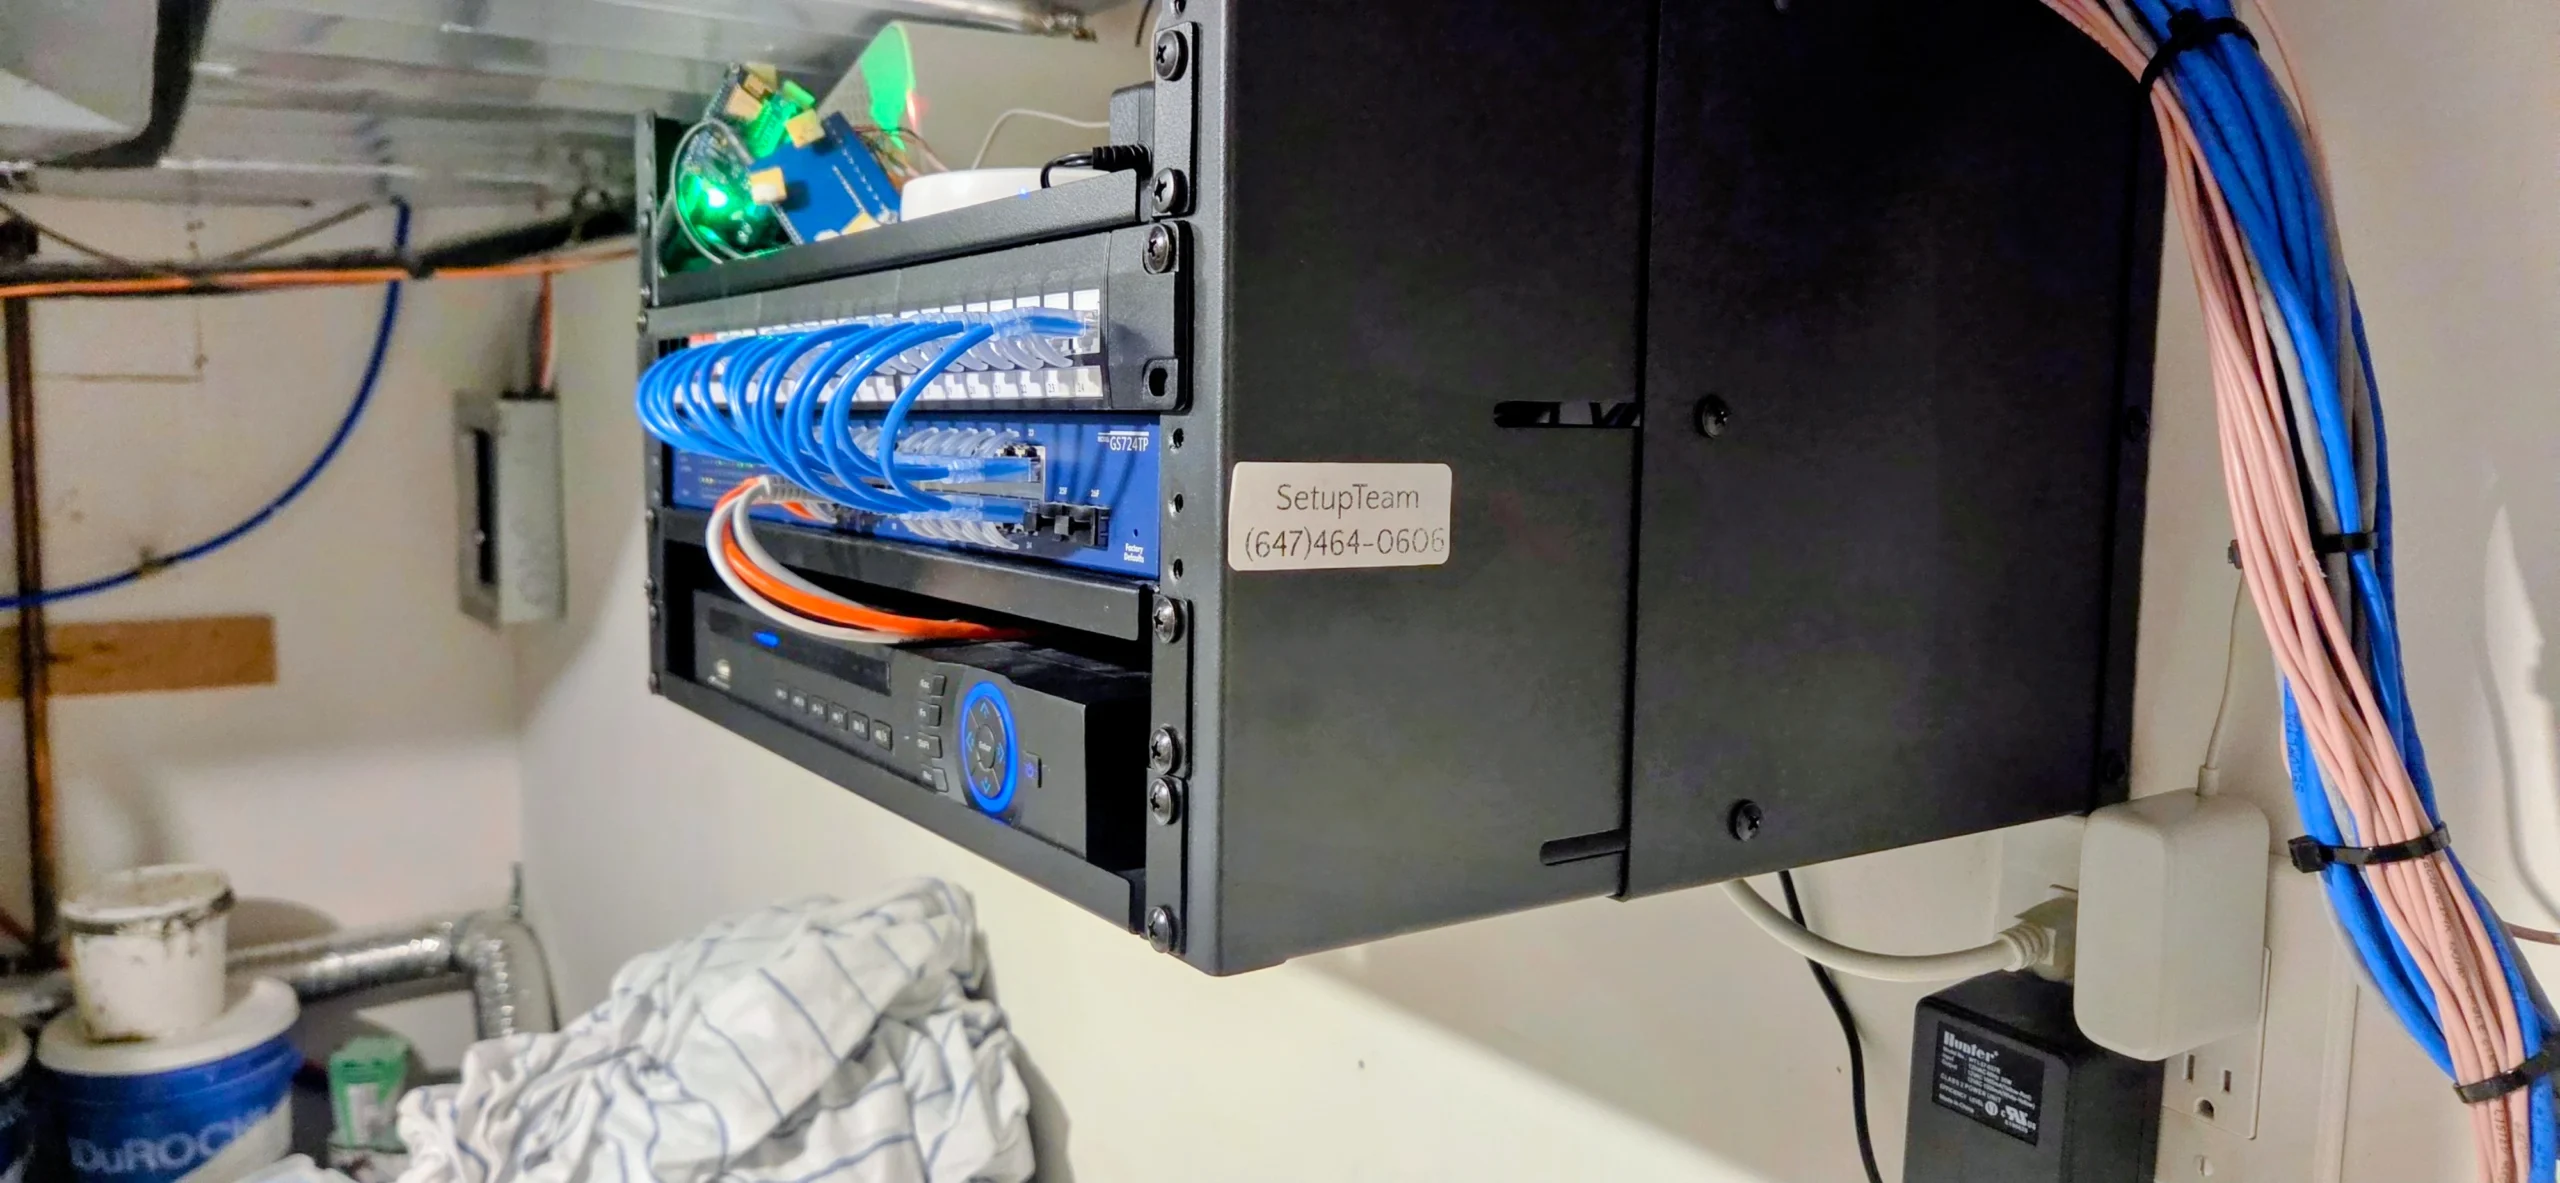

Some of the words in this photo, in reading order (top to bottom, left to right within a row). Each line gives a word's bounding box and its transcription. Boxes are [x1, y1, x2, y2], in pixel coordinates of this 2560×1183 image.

[1048, 383, 1055, 393] 23
[1077, 382, 1085, 392] 24
[1109, 436, 1149, 452] GS724TP
[1276, 483, 1419, 519] SetupTeam
[1245, 526, 1444, 562] (647)464-0606
[1943, 1030, 1995, 1063] Hunter
[1940, 1072, 1960, 1086] CLASS
[1964, 1082, 1986, 1097] POWER
